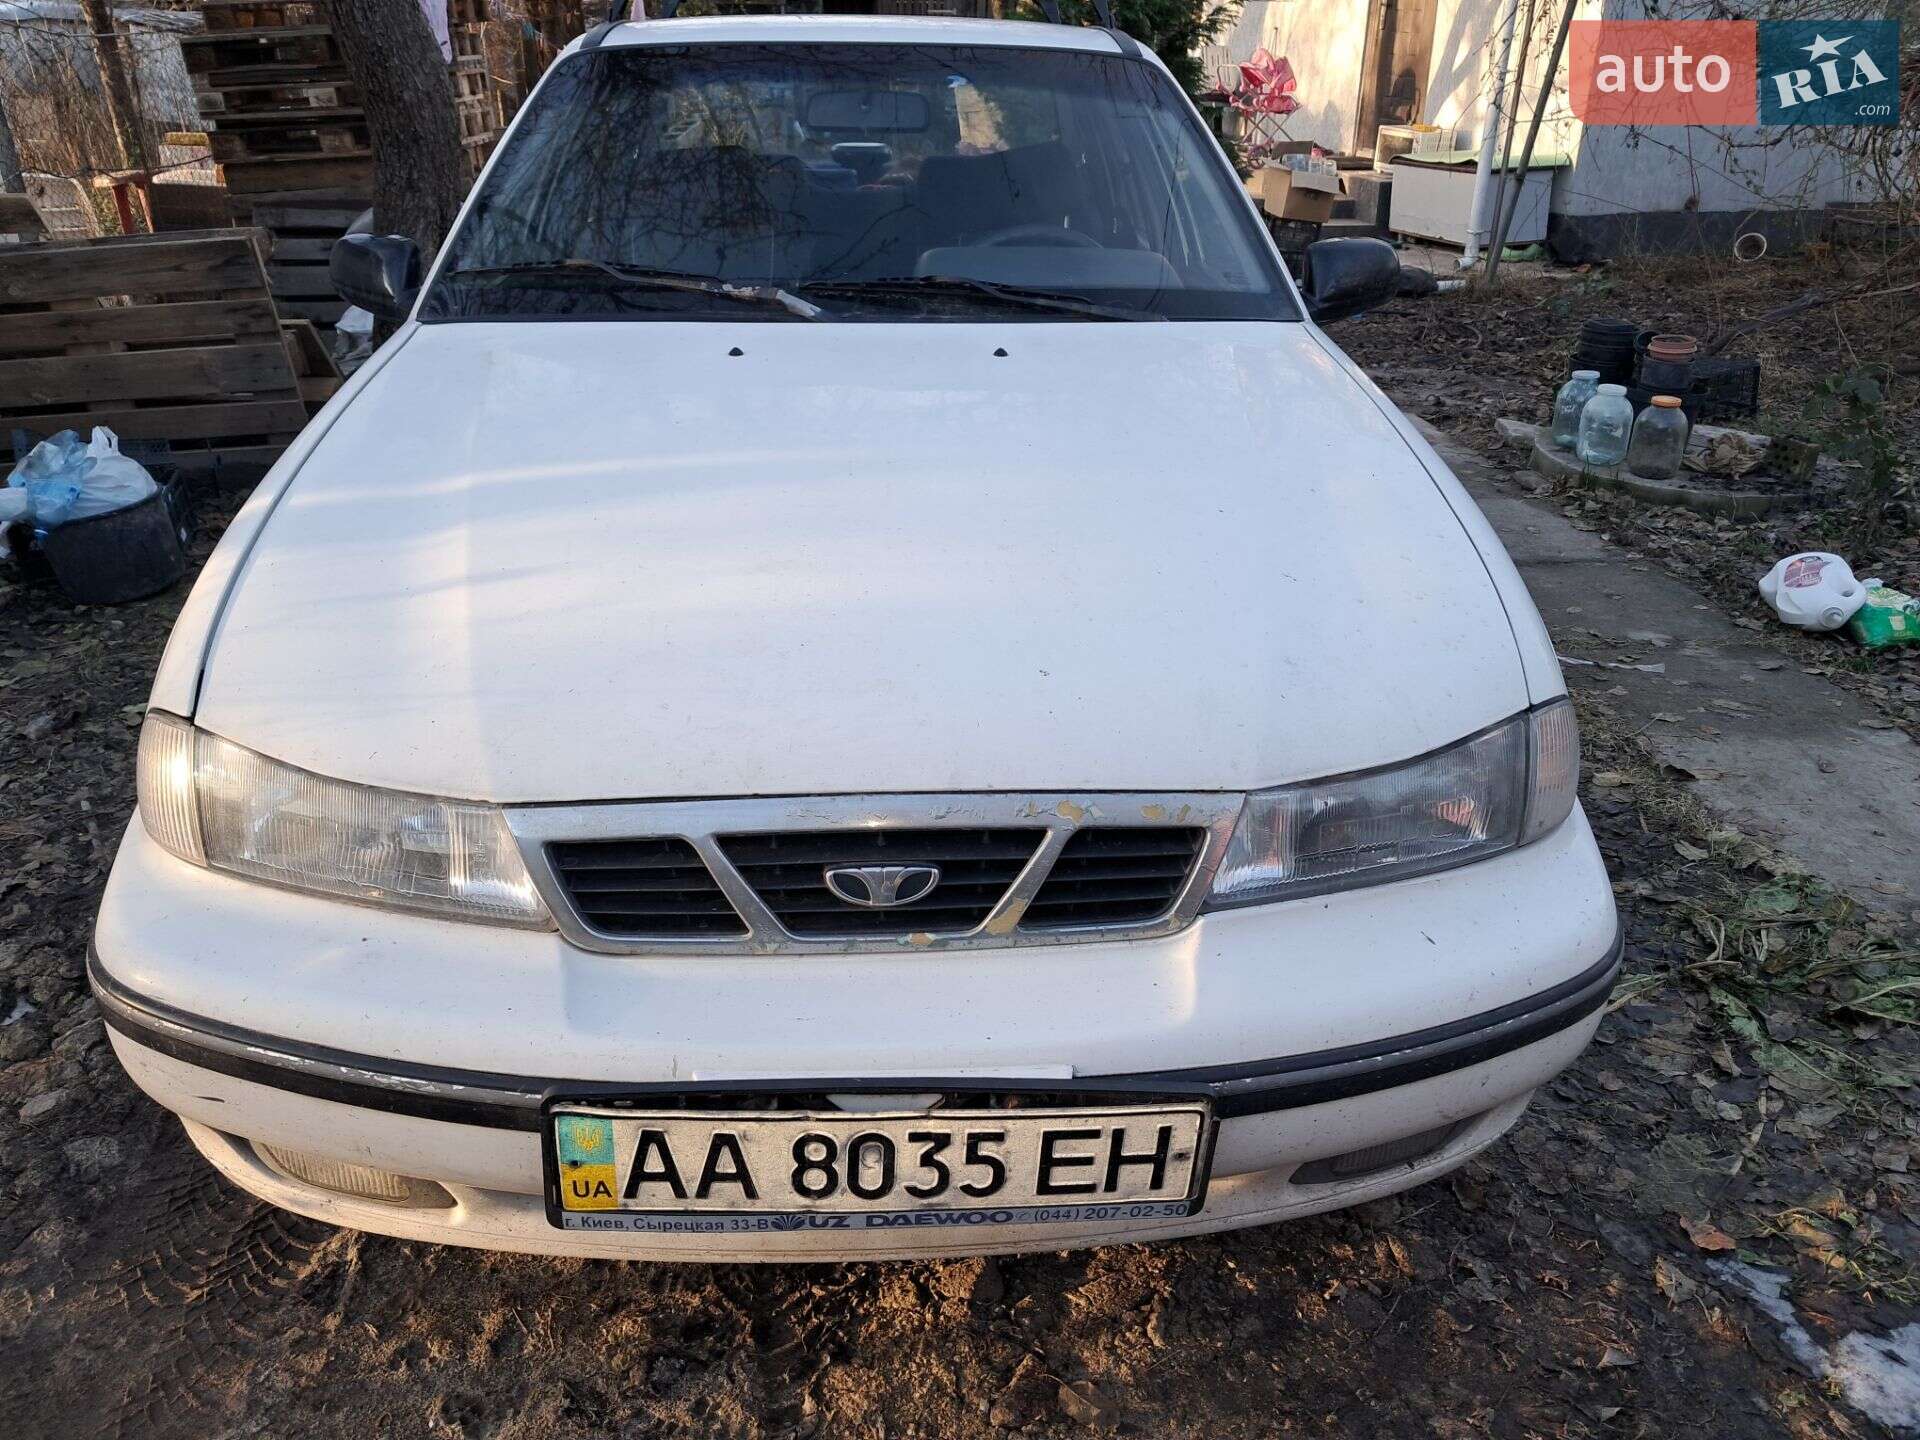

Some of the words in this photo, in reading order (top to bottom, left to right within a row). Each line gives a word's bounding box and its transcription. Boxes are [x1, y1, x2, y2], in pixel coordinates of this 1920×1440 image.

[622, 1129, 760, 1200] AA
[791, 1130, 1006, 1200] 8035
[1036, 1124, 1172, 1196] EH
[571, 1180, 613, 1199] UA
[581, 1216, 630, 1231] Киев,
[633, 1217, 725, 1232] Сырецкая
[808, 1215, 851, 1228] UZ
[865, 1210, 1014, 1227] DAEWOO
[1034, 1208, 1080, 1222] (044)
[1083, 1202, 1188, 1220] 207-02-50
